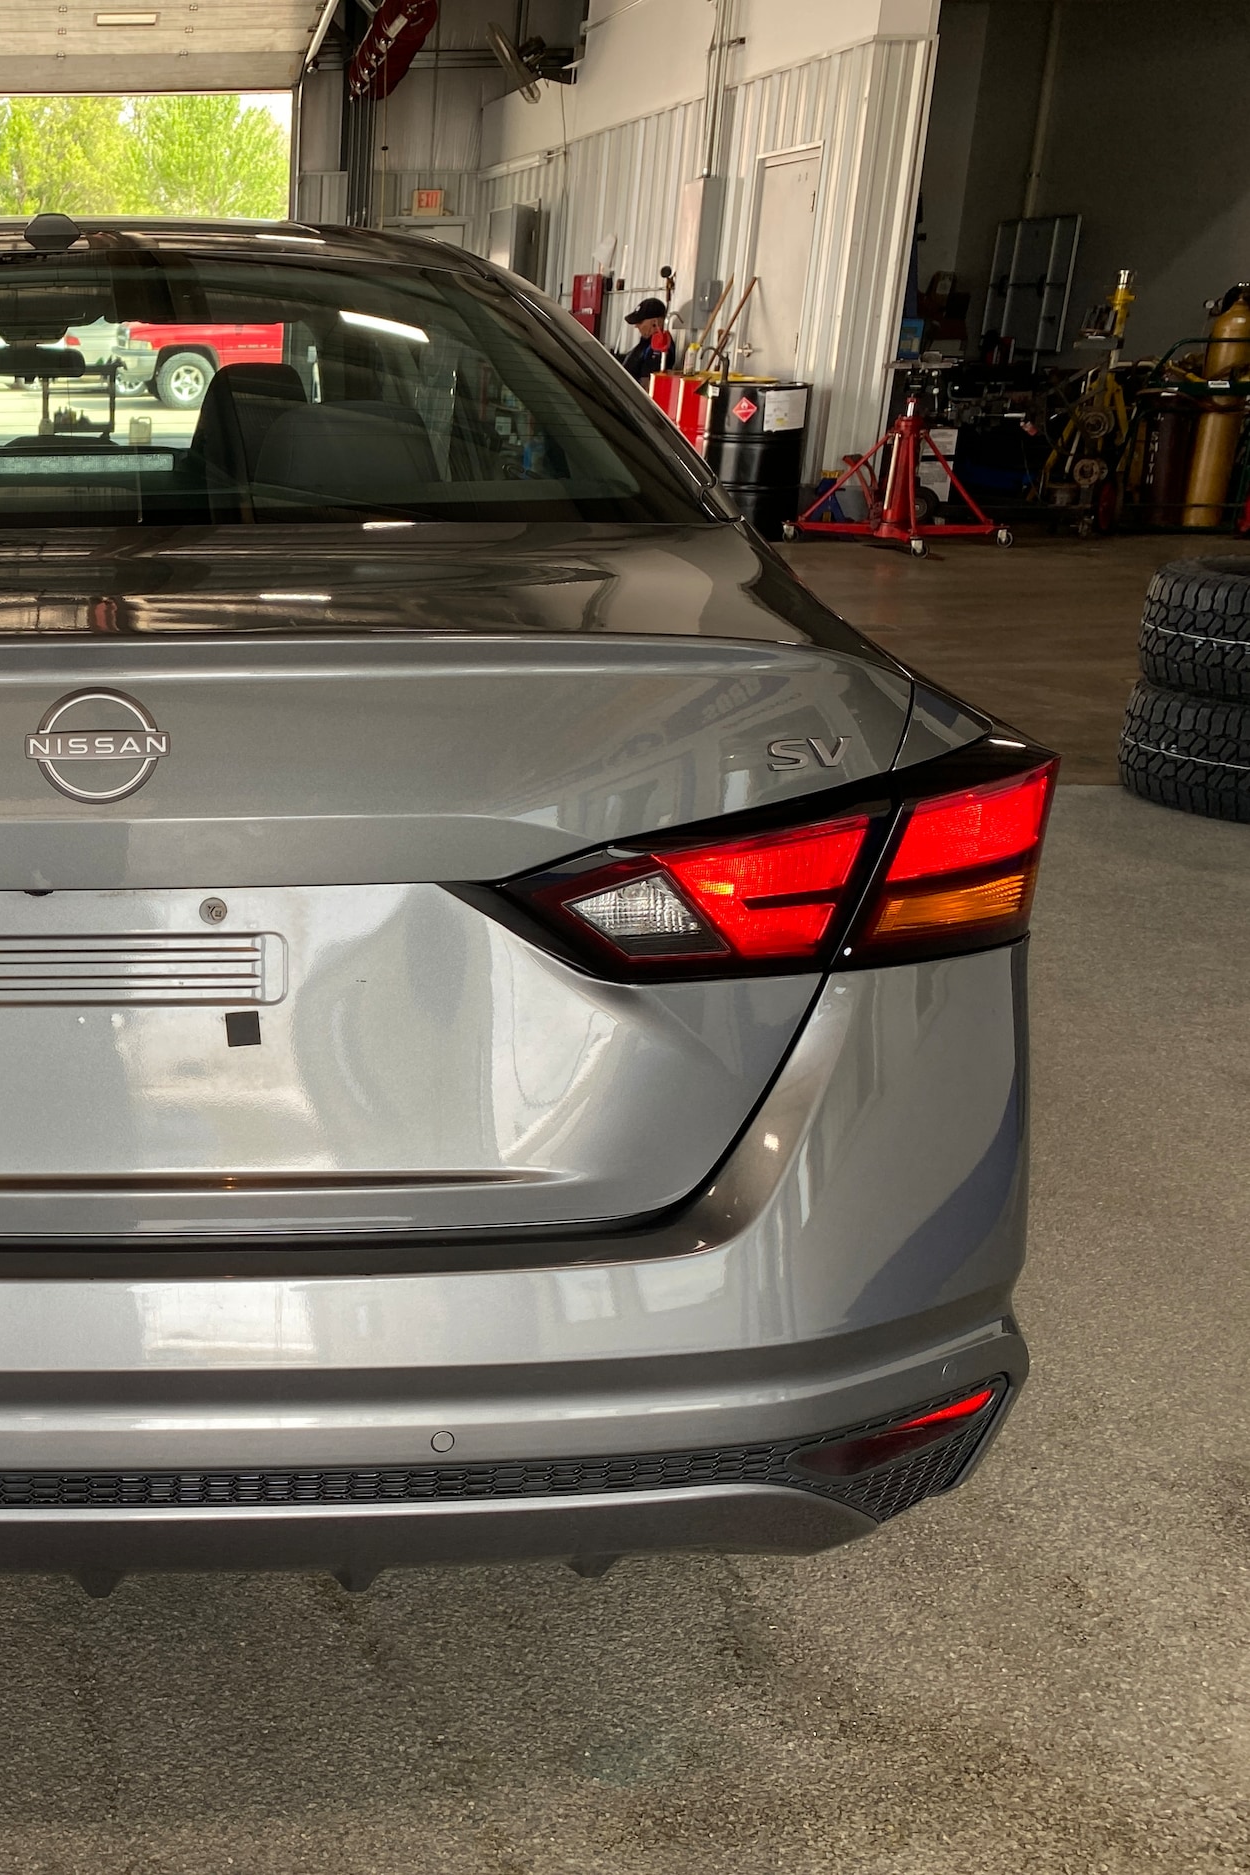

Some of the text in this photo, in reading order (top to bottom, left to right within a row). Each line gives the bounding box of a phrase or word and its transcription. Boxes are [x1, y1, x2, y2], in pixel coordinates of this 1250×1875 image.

[418, 191, 440, 208] EXIT
[29, 736, 167, 755] NISSAN
[767, 736, 852, 771] SV
